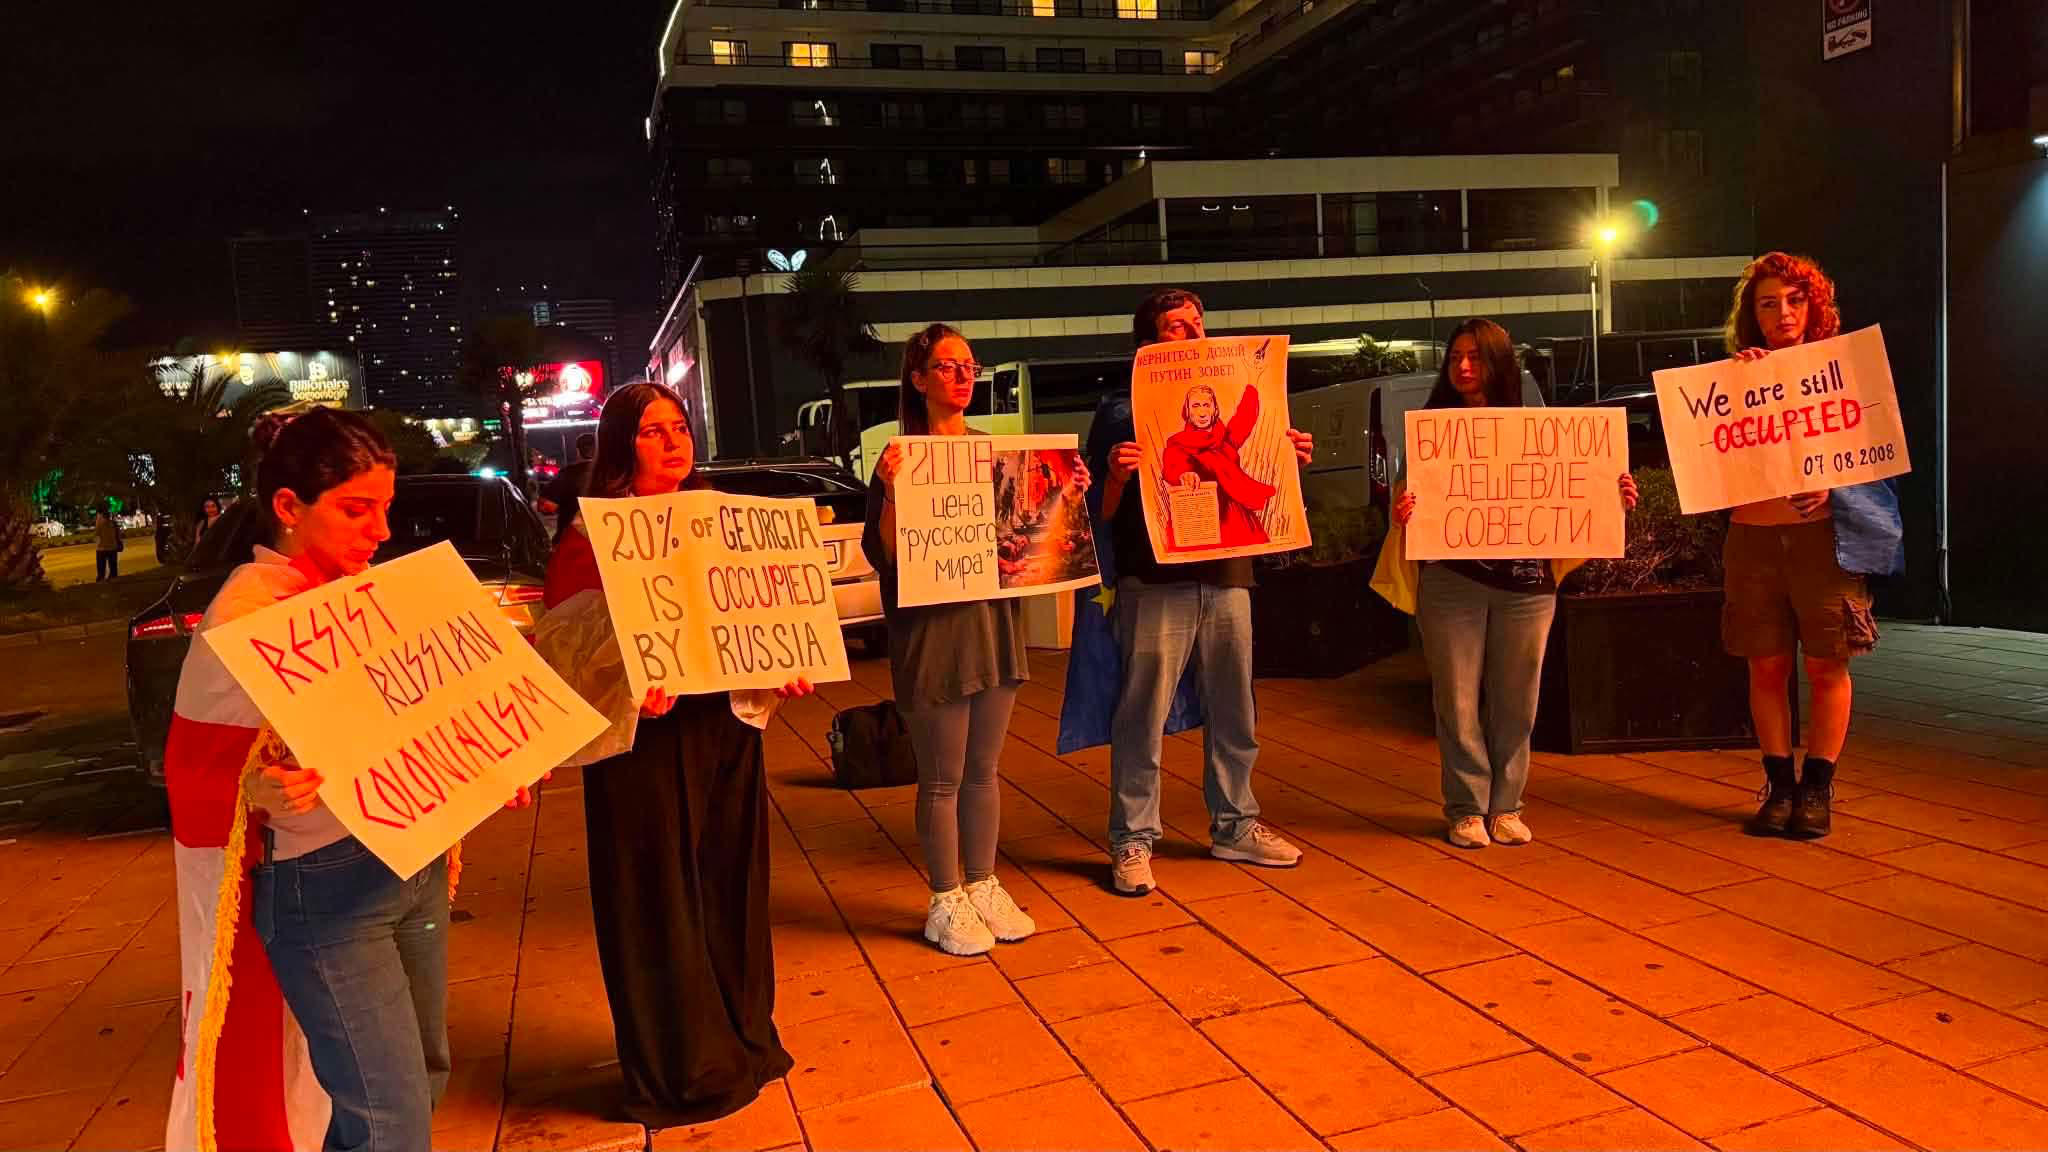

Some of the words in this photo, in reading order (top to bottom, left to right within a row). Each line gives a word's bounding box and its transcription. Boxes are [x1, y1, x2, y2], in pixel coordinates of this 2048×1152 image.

[1150, 367, 1192, 383] ПУТИН
[1679, 381, 1731, 419] We
[1745, 383, 1784, 408] are
[1801, 360, 1844, 396] still
[1417, 417, 1504, 461] БИЛЕТ
[1713, 398, 1861, 453] OCCUPIED
[909, 440, 993, 485] 2008
[1446, 462, 1588, 502] ДЕШЕВЛЕ
[1804, 455, 1824, 476] 07
[603, 506, 679, 561] 20%
[719, 505, 819, 553] GEORGIA
[932, 493, 984, 520] цена
[1444, 505, 1592, 548] СОВЕСТИ
[642, 575, 683, 622] IS
[708, 564, 826, 612] OCCUPIED
[250, 582, 397, 695] RESIST
[364, 611, 502, 716] RUSSIAN
[633, 628, 685, 682] BY
[711, 622, 828, 675] RUSSIA
[354, 675, 568, 830] COLONIALISM
